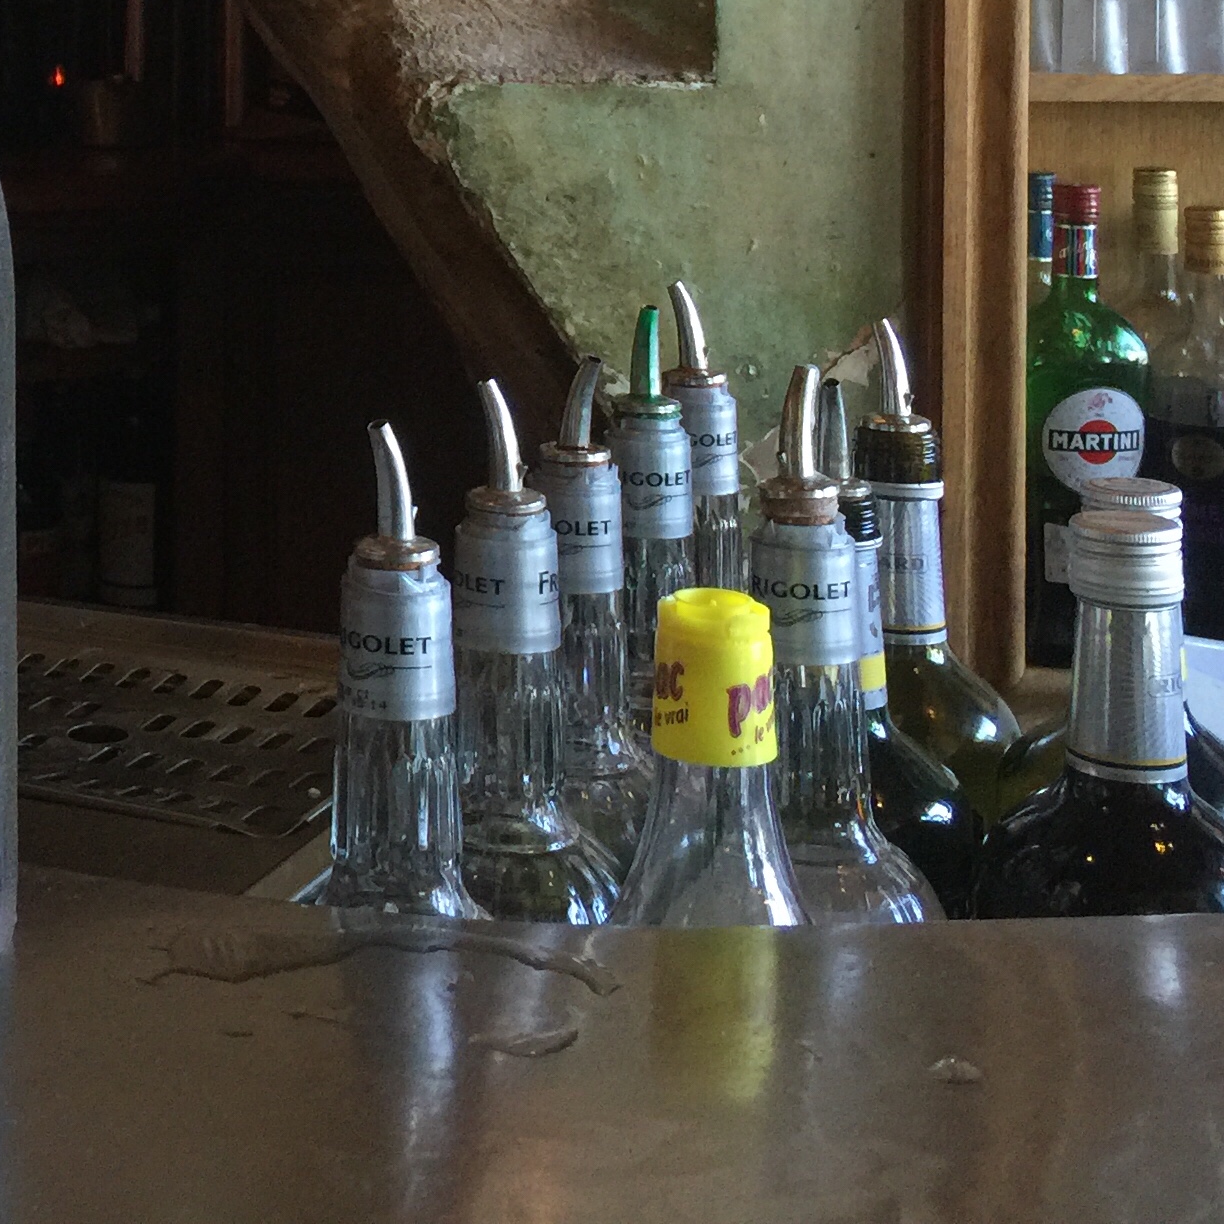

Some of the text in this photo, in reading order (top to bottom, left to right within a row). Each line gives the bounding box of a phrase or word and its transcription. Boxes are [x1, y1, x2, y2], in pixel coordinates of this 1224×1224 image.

[1052, 431, 1138, 451] MARTINI
[554, 519, 612, 536] OLET
[751, 574, 851, 600] RIGOLET
[665, 702, 690, 726] vrai
[726, 665, 774, 739] pa
